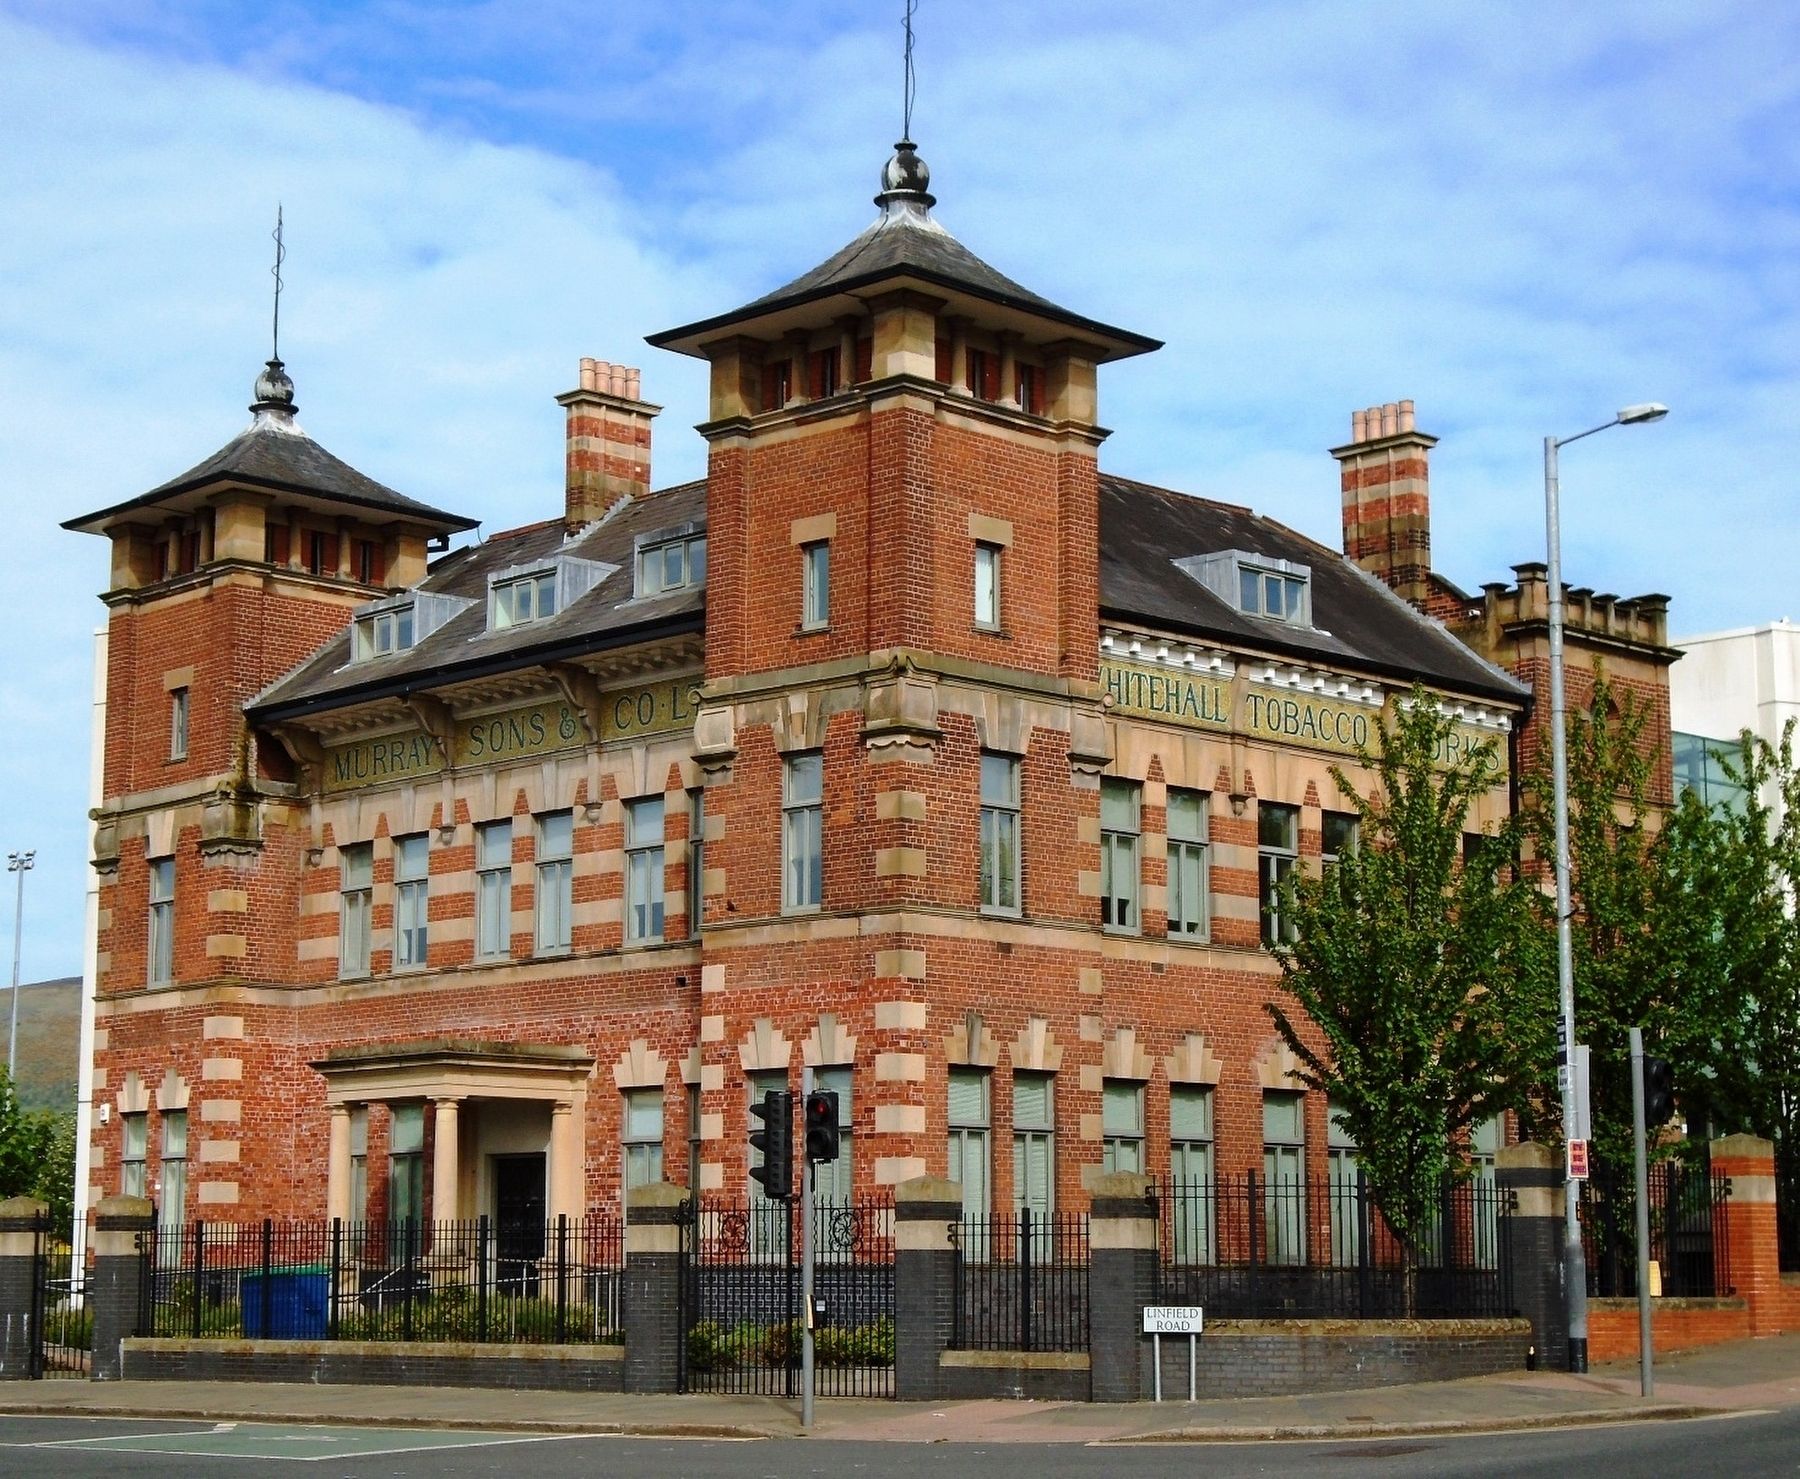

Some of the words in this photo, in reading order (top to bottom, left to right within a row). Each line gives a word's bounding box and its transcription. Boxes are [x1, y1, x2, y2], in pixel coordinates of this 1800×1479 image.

[1246, 693, 1367, 748] TOBACCO
[334, 734, 434, 783] MURRAY
[469, 713, 546, 757] SONS
[558, 707, 577, 742] &
[1146, 1308, 1199, 1319] LINFIELD
[1156, 1320, 1191, 1331] ROAD
